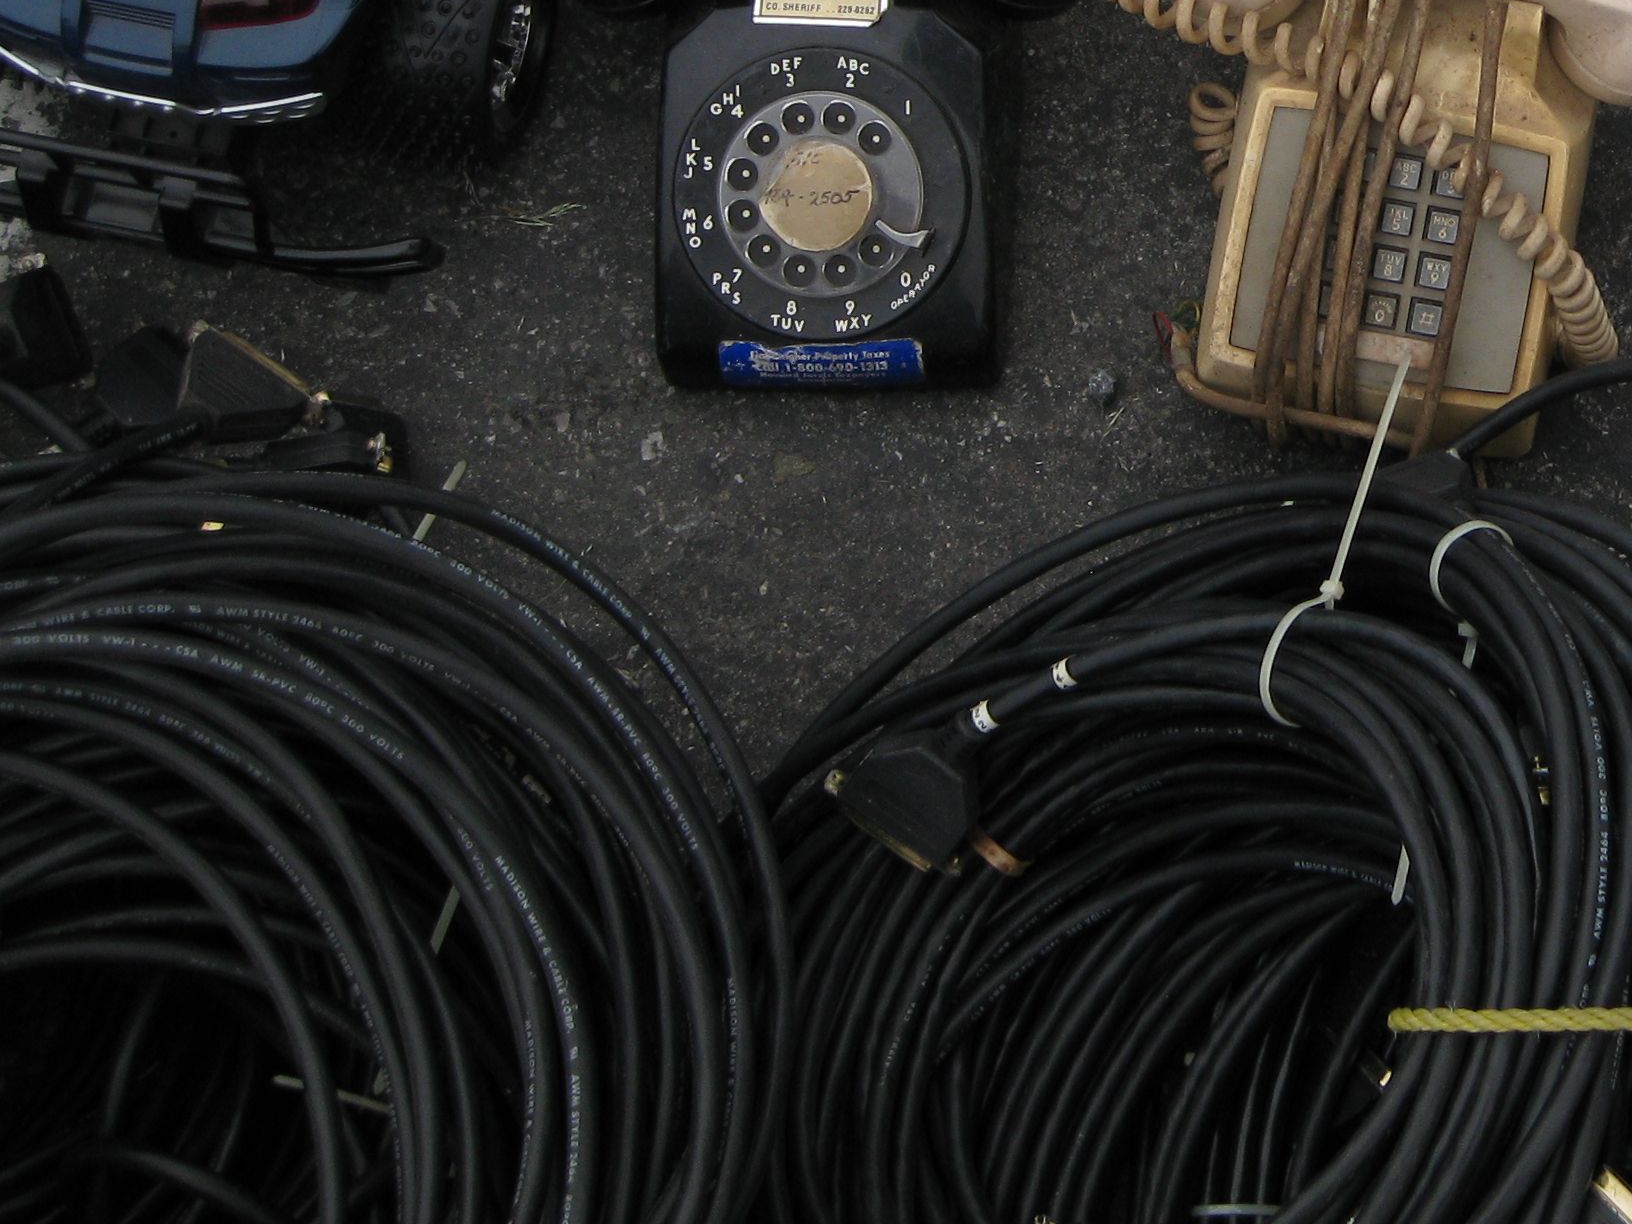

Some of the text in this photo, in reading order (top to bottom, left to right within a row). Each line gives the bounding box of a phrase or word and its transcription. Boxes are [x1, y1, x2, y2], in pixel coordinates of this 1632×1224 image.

[783, 2, 822, 13] SHERIFF
[770, 57, 802, 75] DEF
[837, 56, 870, 75] ABC
[785, 73, 795, 88] 3
[845, 73, 855, 88] 2
[730, 103, 744, 119] 4
[703, 156, 713, 171] 5
[1400, 174, 1409, 186] 2
[703, 214, 713, 230] 6
[1391, 219, 1401, 231] 5
[1433, 215, 1457, 227] MNO
[1438, 227, 1447, 239] 6
[732, 268, 742, 283] 7
[1384, 264, 1393, 276] 8
[1430, 271, 1440, 284] 9
[712, 272, 741, 305] PRS
[890, 264, 936, 310] OPERATOR
[786, 300, 797, 316] 8
[845, 300, 855, 316] 9
[770, 314, 805, 333] TUV
[835, 314, 872, 333] WXY
[216, 605, 249, 618] AWM
[252, 608, 289, 623] STYLE
[49, 632, 91, 645] VOLTS
[175, 643, 200, 659] CSA
[209, 654, 244, 674] AWM
[1597, 866, 1610, 911] STYLE
[494, 854, 532, 911] MADISON
[525, 908, 548, 946] WIRE
[570, 1073, 583, 1109] AWM
